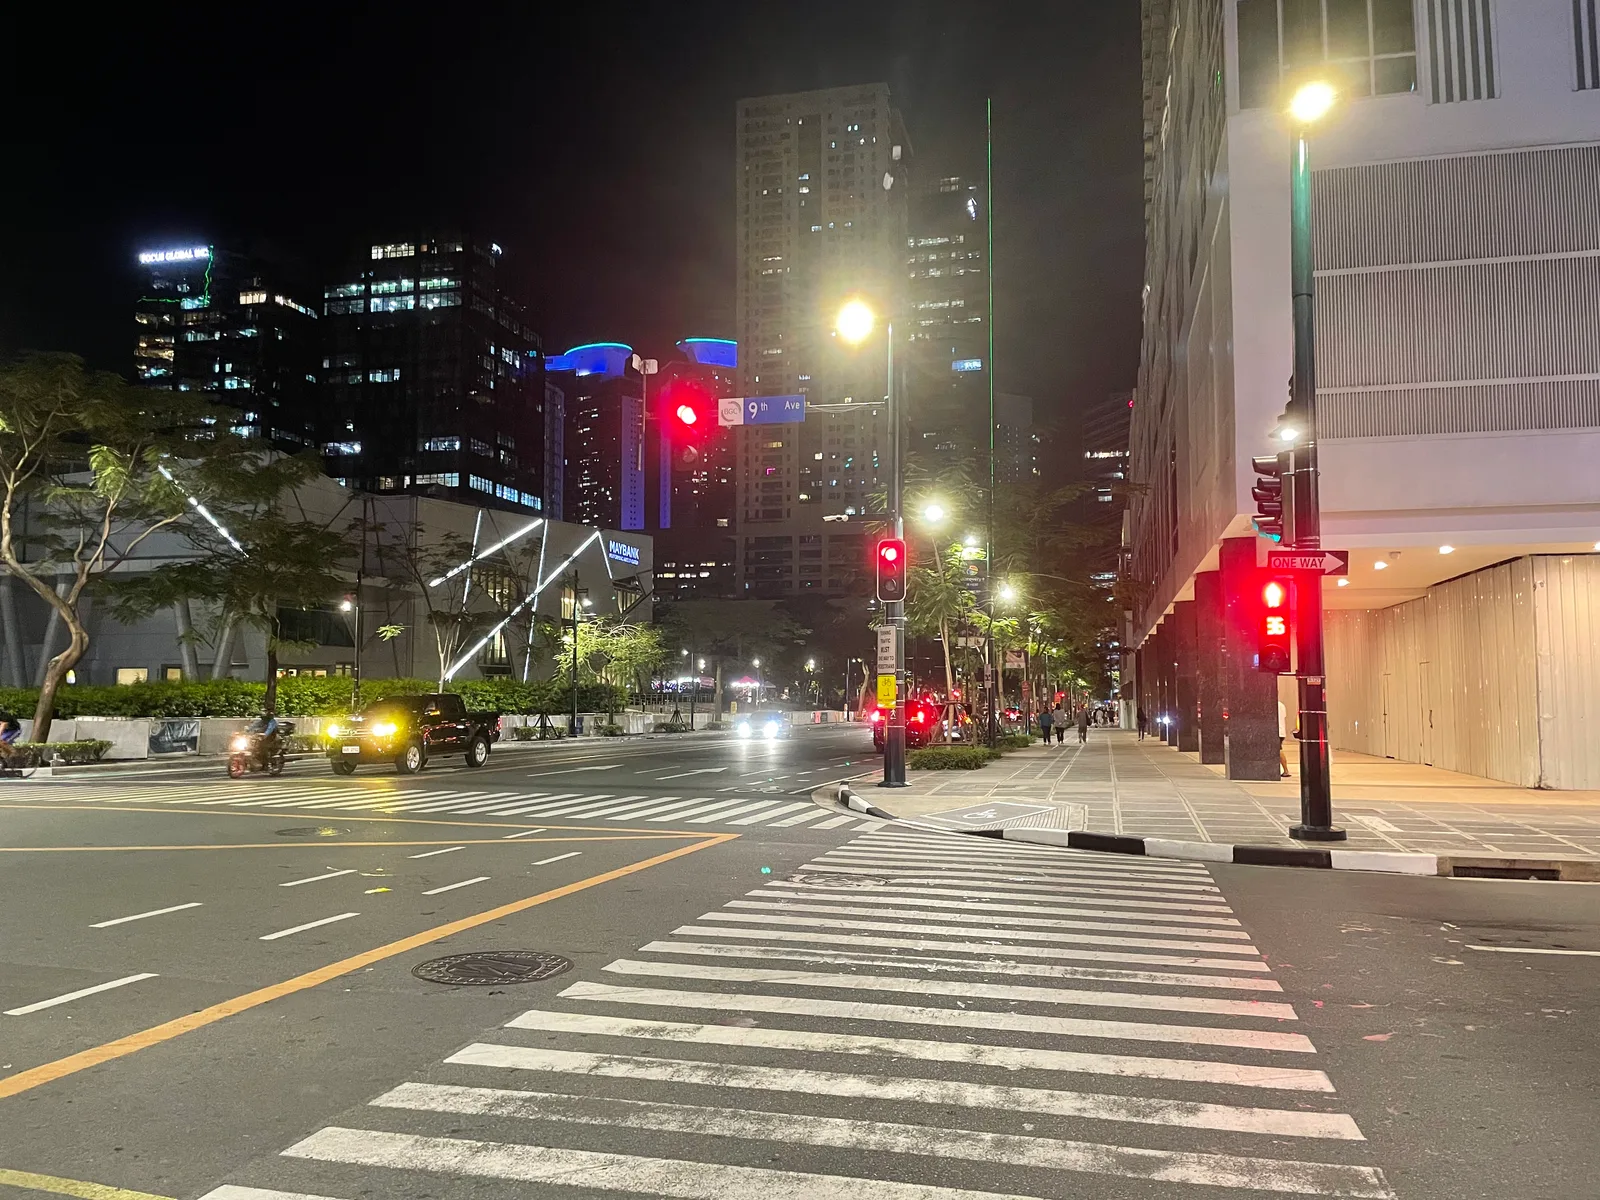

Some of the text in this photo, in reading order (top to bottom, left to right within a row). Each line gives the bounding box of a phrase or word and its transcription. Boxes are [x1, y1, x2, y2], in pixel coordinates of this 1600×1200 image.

[784, 400, 800, 410] Ave
[610, 540, 640, 560] MAYBANK
[1273, 558, 1324, 568] ONE WAY
